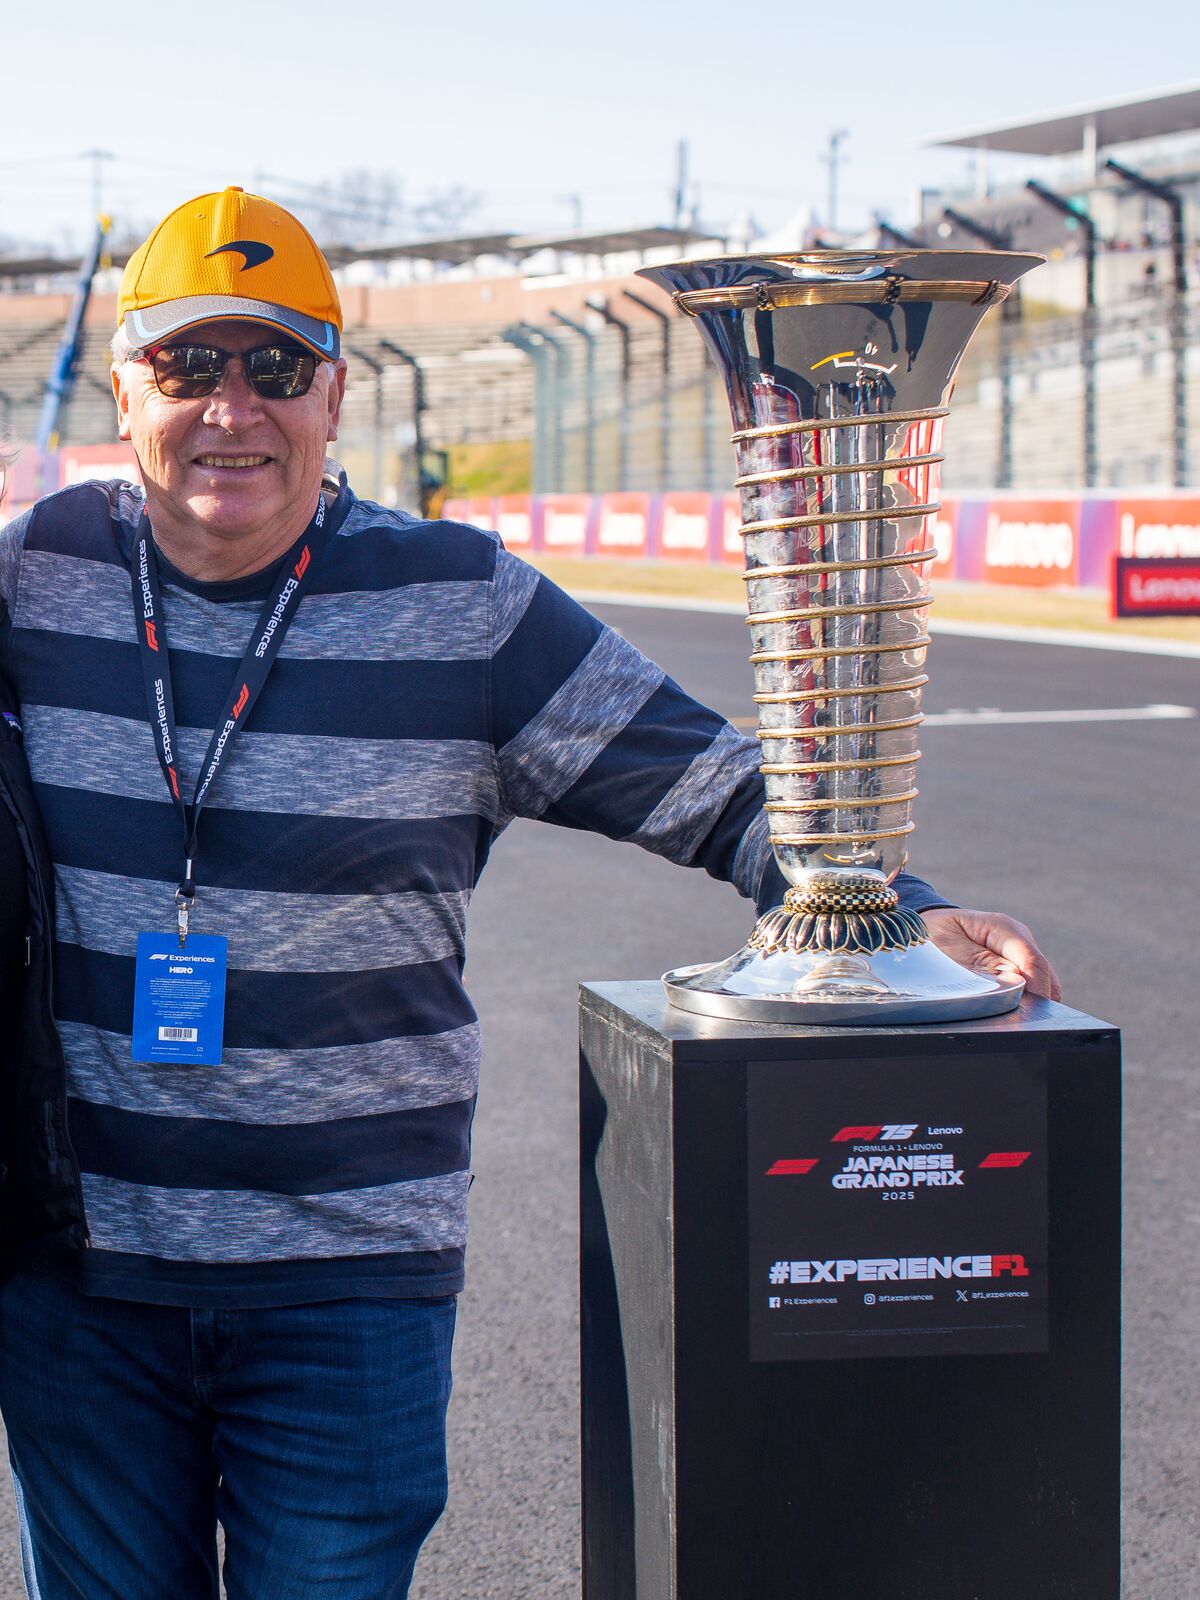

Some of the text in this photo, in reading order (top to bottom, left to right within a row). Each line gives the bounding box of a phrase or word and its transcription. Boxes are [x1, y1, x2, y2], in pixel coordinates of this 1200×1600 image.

[139, 538, 154, 619] Experiences
[255, 577, 299, 659] Experiences
[155, 678, 173, 764] Experiences
[169, 954, 215, 963] Experiences
[169, 966, 194, 974] HERO
[880, 1124, 919, 1141] 75
[928, 1125, 963, 1135] Lenovo
[853, 1142, 943, 1152] FORMULA 1 LENOVO
[842, 1154, 954, 1173] JAPANESE
[831, 1170, 965, 1190] GRAND PRIX
[882, 1191, 915, 1201] 2025
[769, 1254, 1030, 1284] #EXPERIENCEF1
[794, 1296, 838, 1305] Experiences
